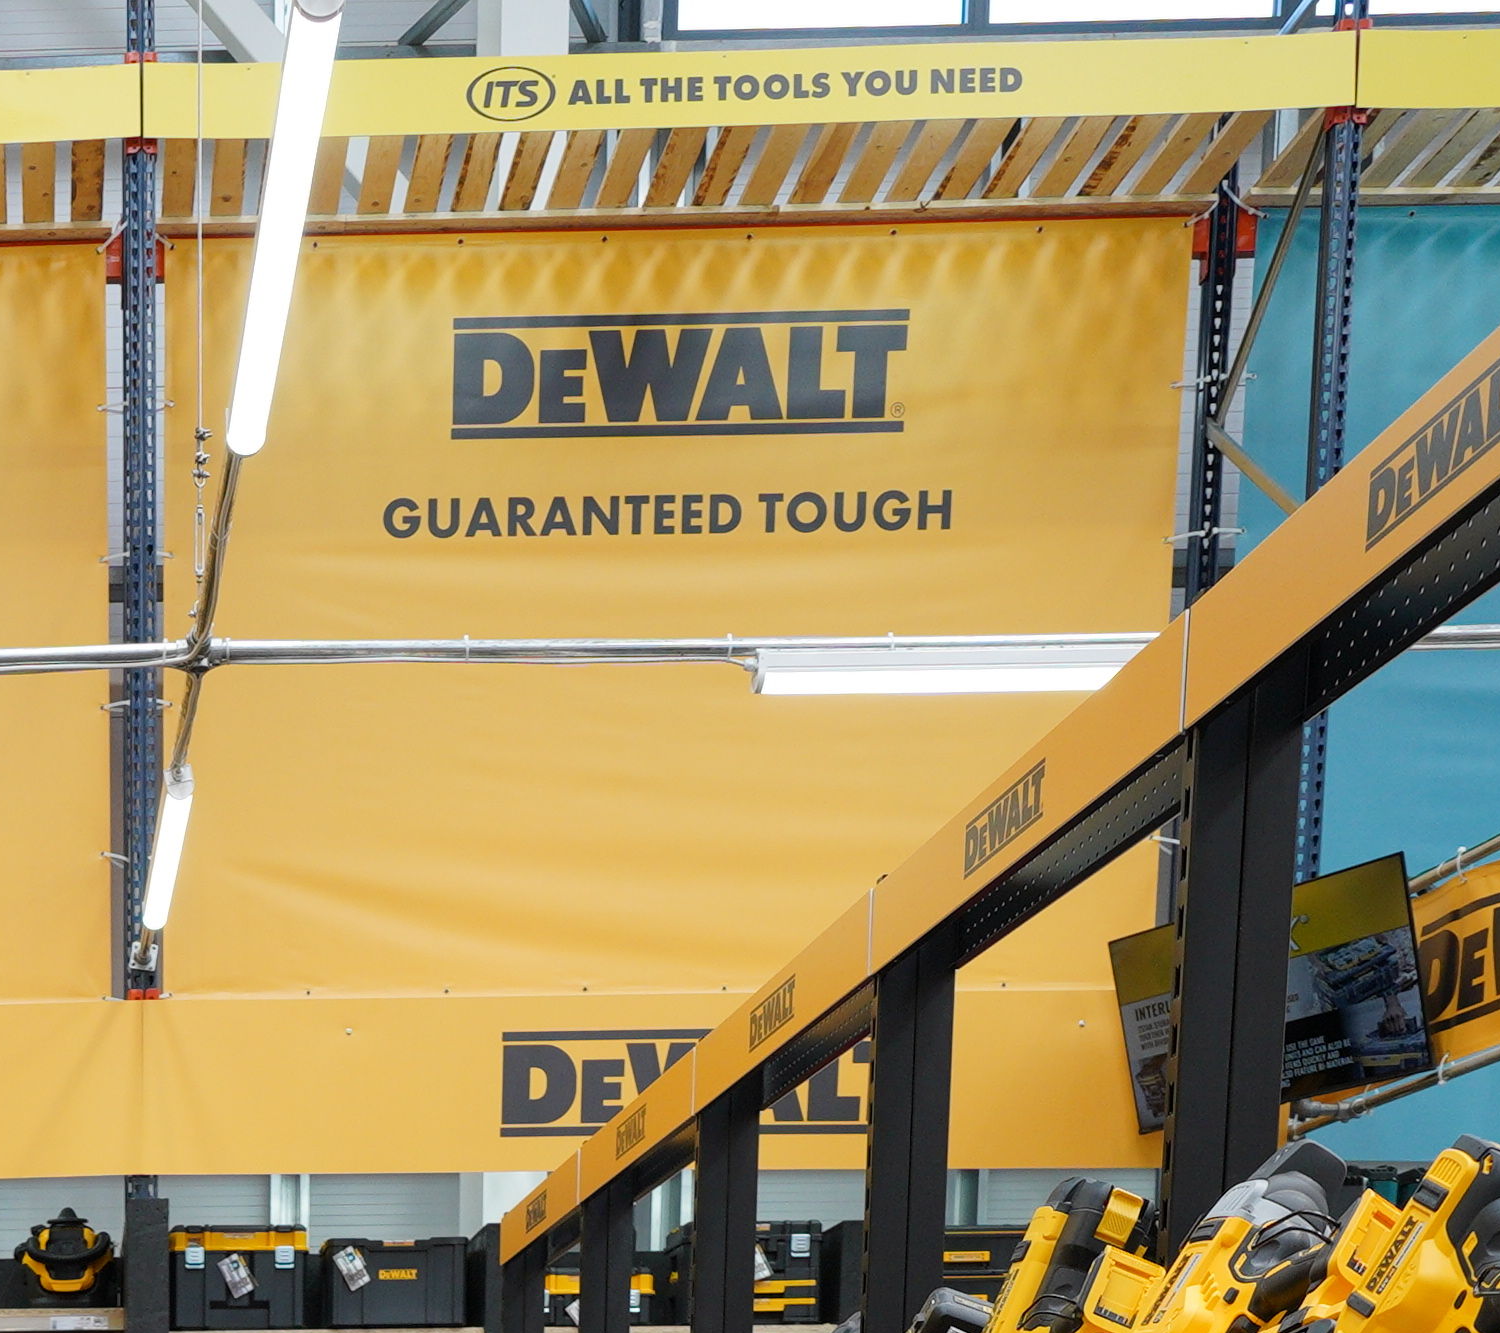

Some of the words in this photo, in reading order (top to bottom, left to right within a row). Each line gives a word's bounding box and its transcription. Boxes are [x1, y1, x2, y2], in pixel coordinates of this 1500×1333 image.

[483, 80, 540, 108] ITS
[568, 79, 628, 105] ALL
[636, 76, 704, 103] THE
[713, 72, 831, 100] TOOLS
[840, 69, 918, 96] YOU
[929, 67, 1023, 94] NEED
[383, 493, 742, 540] GUARANTEED
[759, 489, 952, 533] TOUGH
